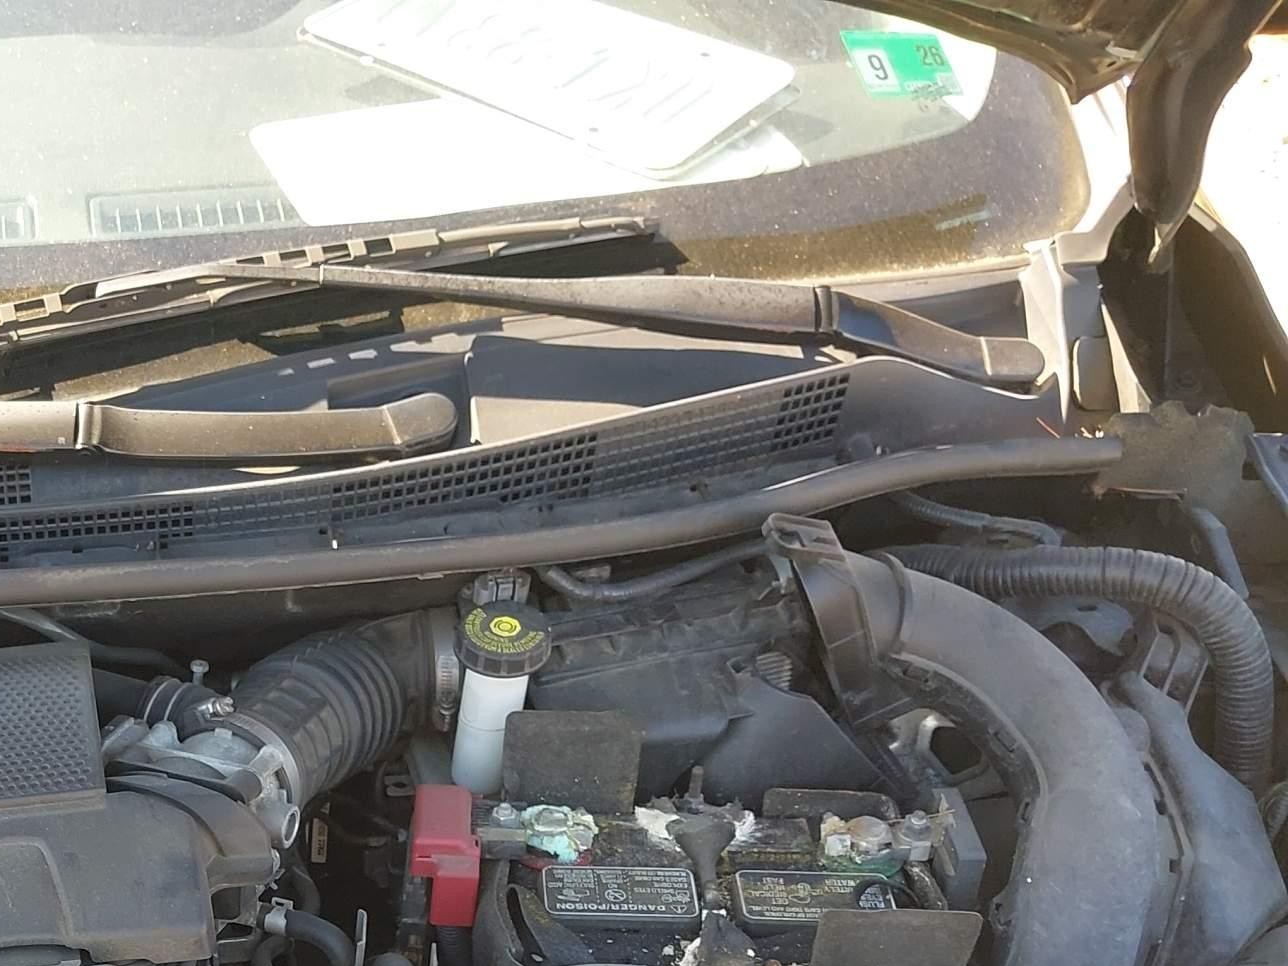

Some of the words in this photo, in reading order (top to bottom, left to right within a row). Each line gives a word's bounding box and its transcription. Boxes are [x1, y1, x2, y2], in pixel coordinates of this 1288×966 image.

[916, 45, 945, 66] 26
[868, 54, 888, 80] 9
[555, 902, 667, 912] DANGER/POISON
